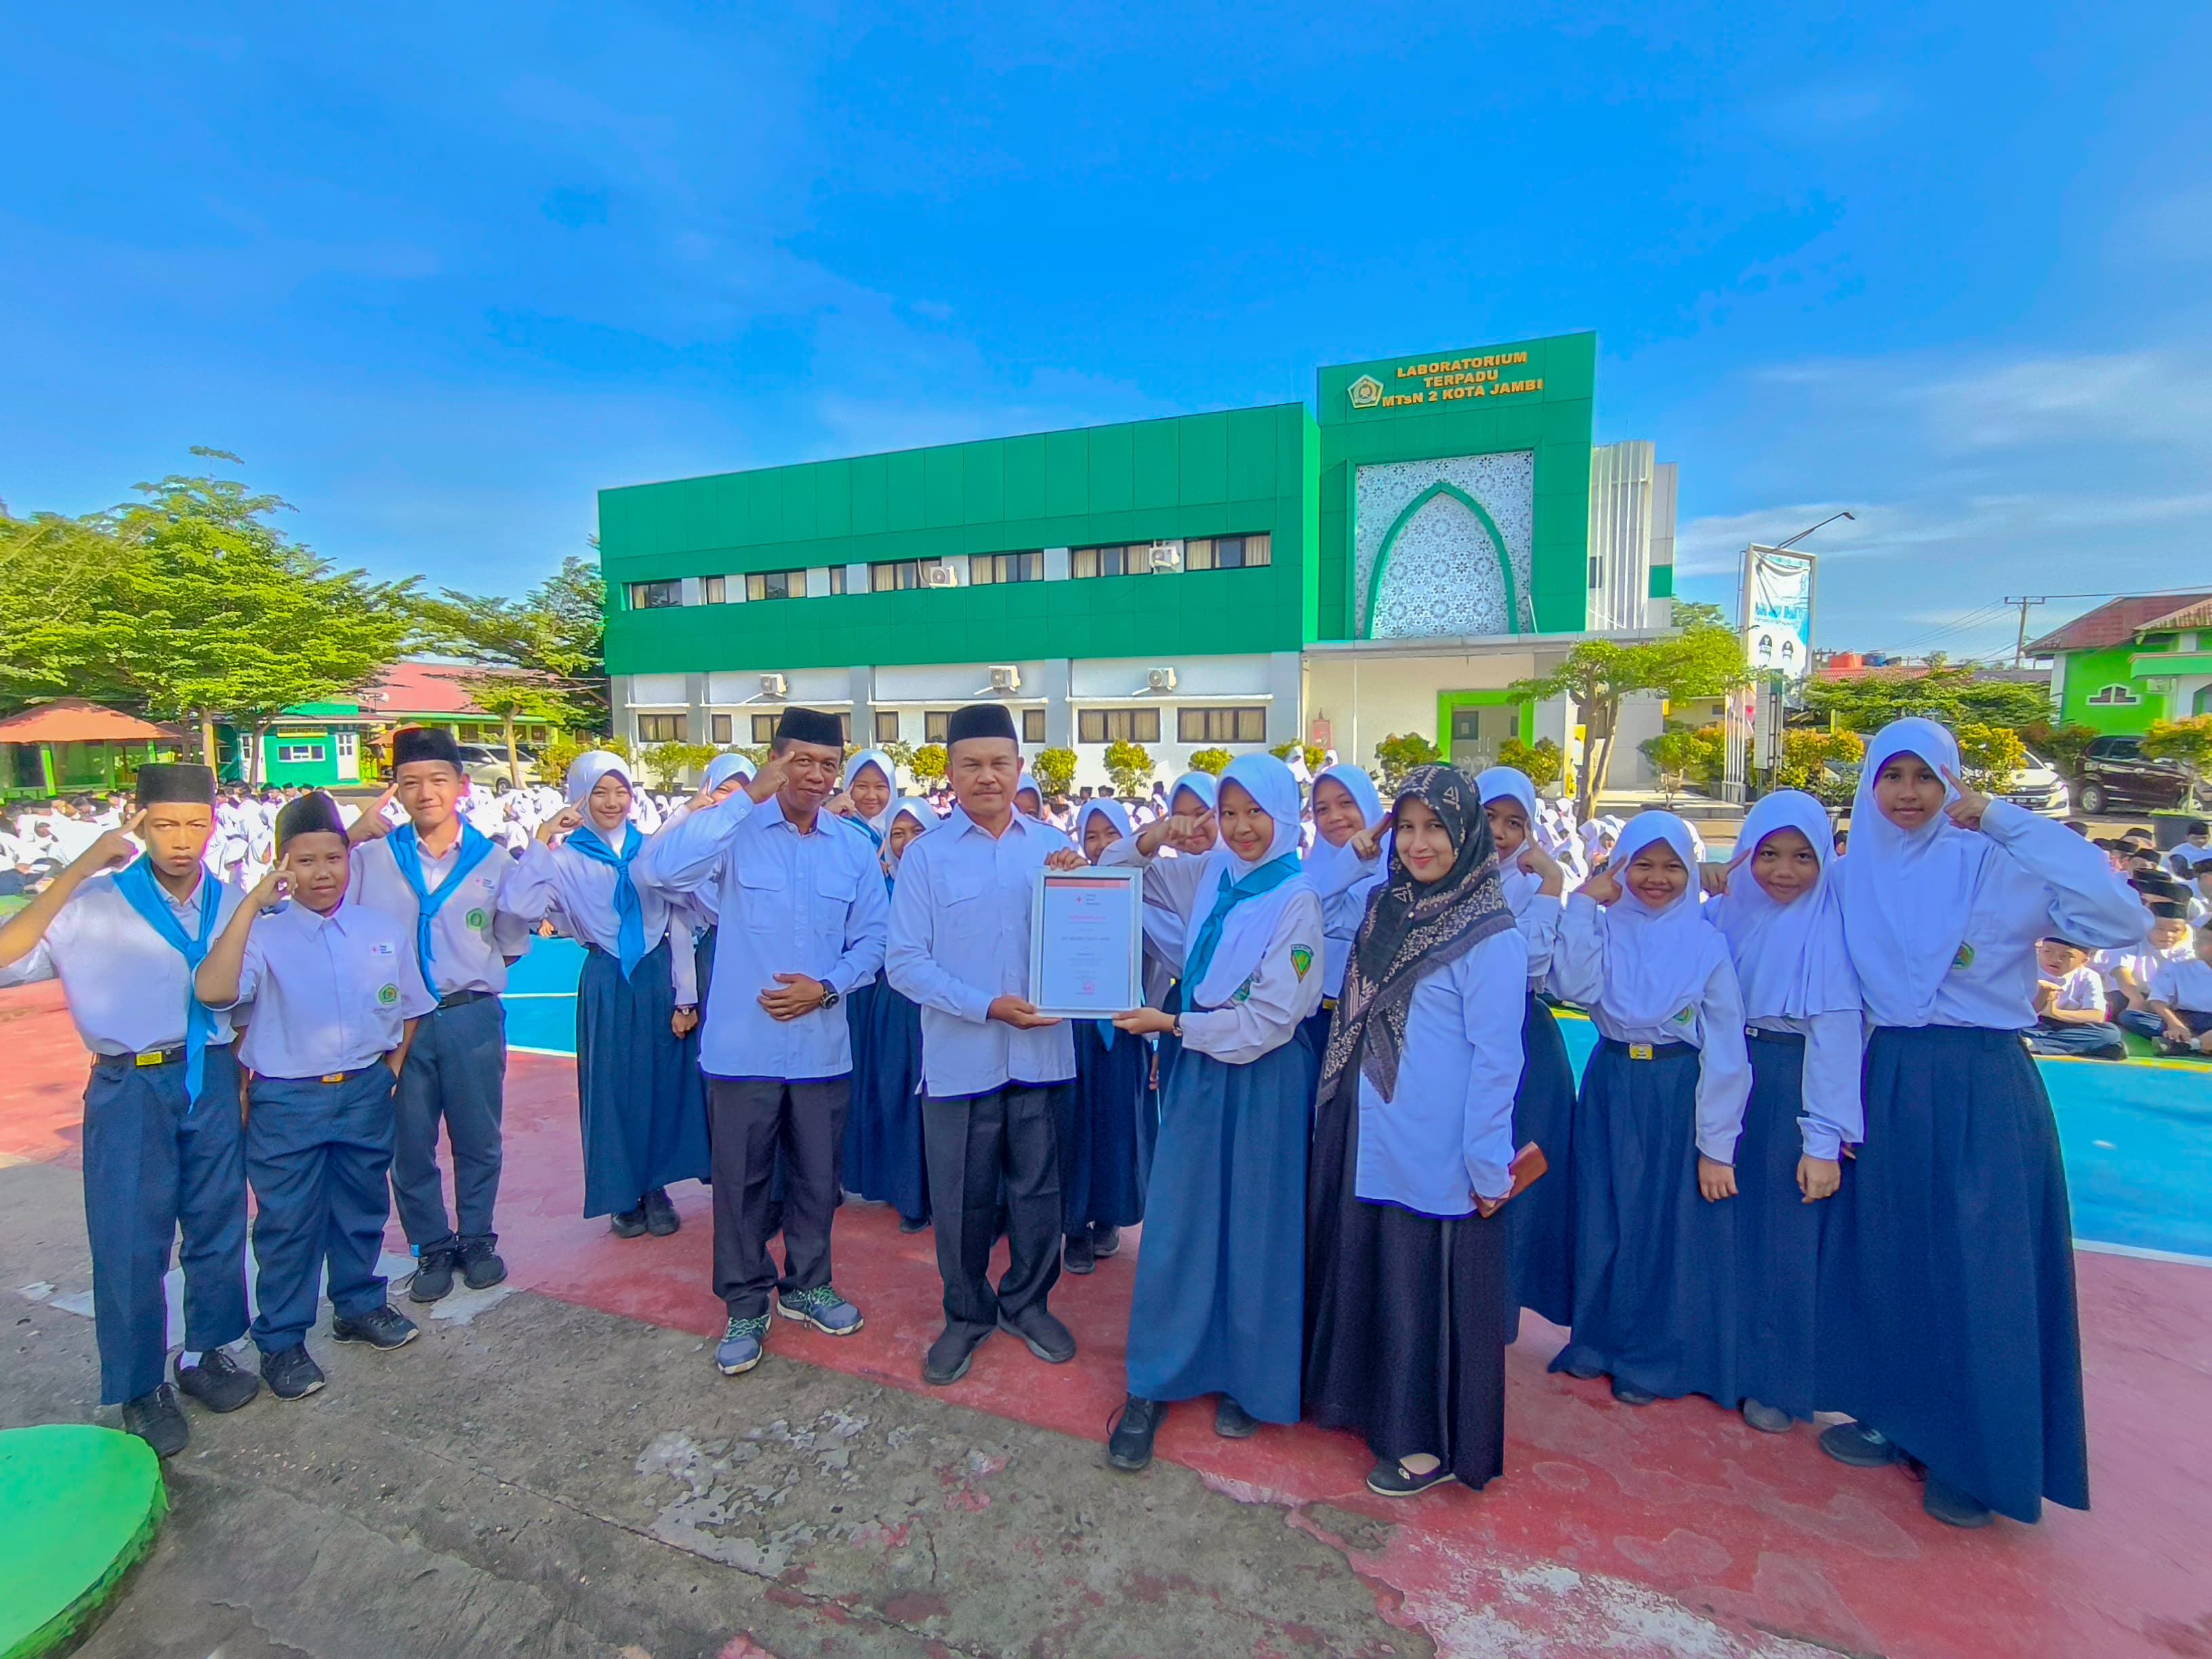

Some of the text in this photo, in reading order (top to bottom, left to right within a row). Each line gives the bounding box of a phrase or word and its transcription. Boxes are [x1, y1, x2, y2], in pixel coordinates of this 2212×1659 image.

[1397, 352, 1528, 378] LABORATORIUM
[1423, 369, 1498, 388] TERPADU
[1382, 378, 1543, 407] MTsN 2 KOTA JAMBI
